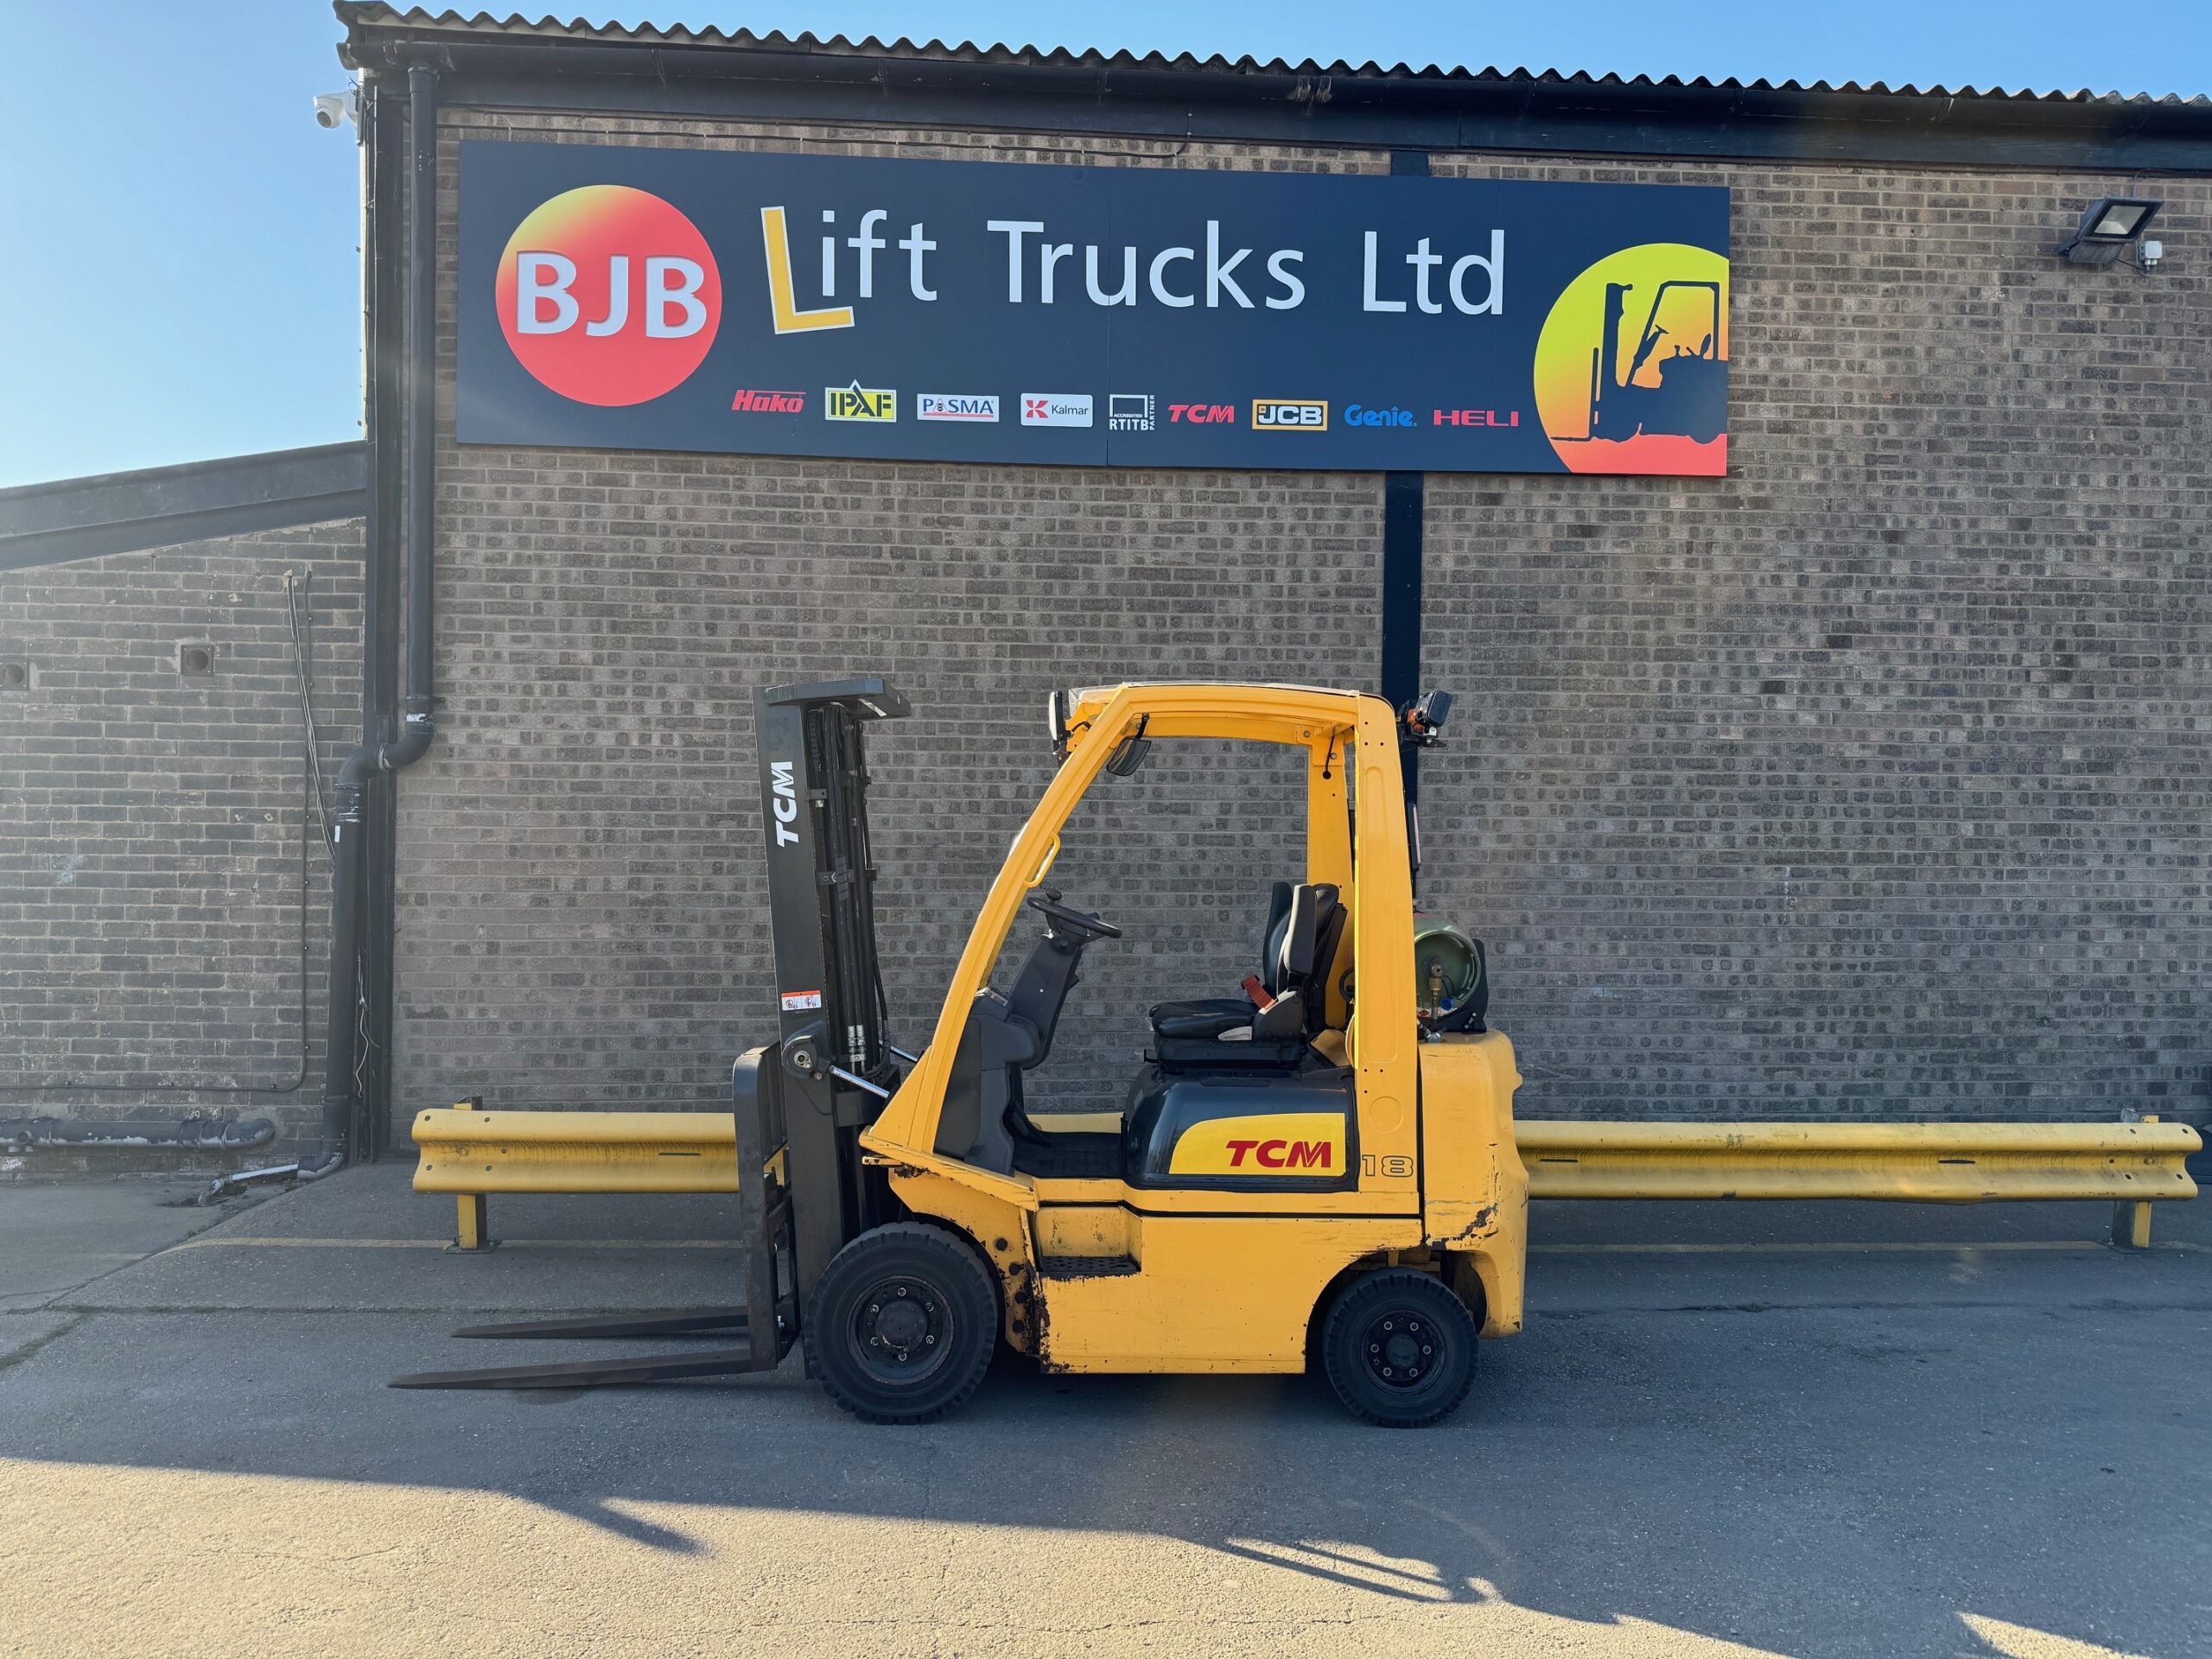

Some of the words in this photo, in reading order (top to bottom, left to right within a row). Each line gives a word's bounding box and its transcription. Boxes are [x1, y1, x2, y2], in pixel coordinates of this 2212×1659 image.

[517, 251, 708, 338] BJB
[760, 206, 938, 334] Lift
[987, 219, 1306, 310] Trucks
[1363, 228, 1505, 315] Ltd
[732, 390, 805, 413] Hako
[830, 385, 892, 417] IPAF
[1052, 404, 1090, 416] Kalmar
[1109, 418, 1149, 430] RTITB
[1168, 404, 1235, 423] TCM
[1258, 405, 1322, 424] JCB
[1433, 410, 1519, 426] HELI
[771, 760, 799, 848] TCM
[1225, 1140, 1332, 1168] TCM
[1362, 1154, 1414, 1178] 18
